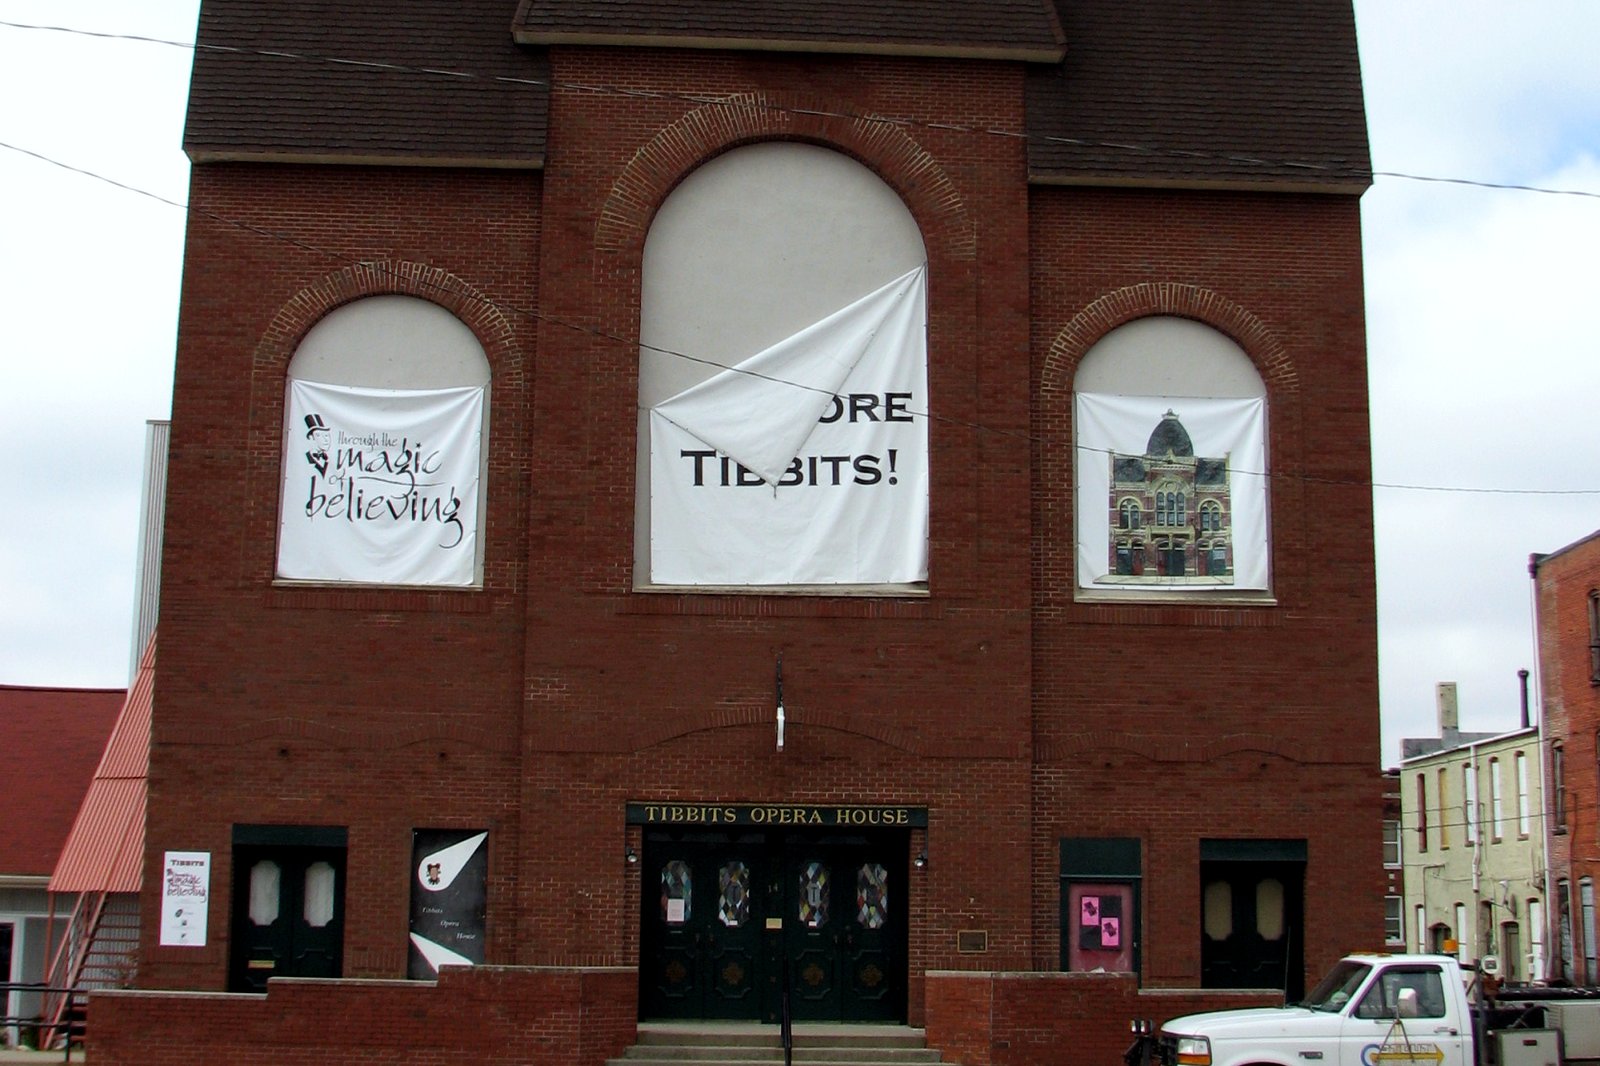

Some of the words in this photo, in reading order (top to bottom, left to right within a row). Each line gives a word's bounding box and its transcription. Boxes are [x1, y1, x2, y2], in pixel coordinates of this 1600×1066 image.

[338, 431, 379, 453] through
[382, 432, 398, 447] the
[336, 437, 442, 499] magic
[328, 469, 347, 491] of
[305, 475, 464, 549] believing
[644, 806, 737, 823] TIBBITS
[750, 807, 823, 824] OPERA
[836, 809, 909, 824] HOUSE
